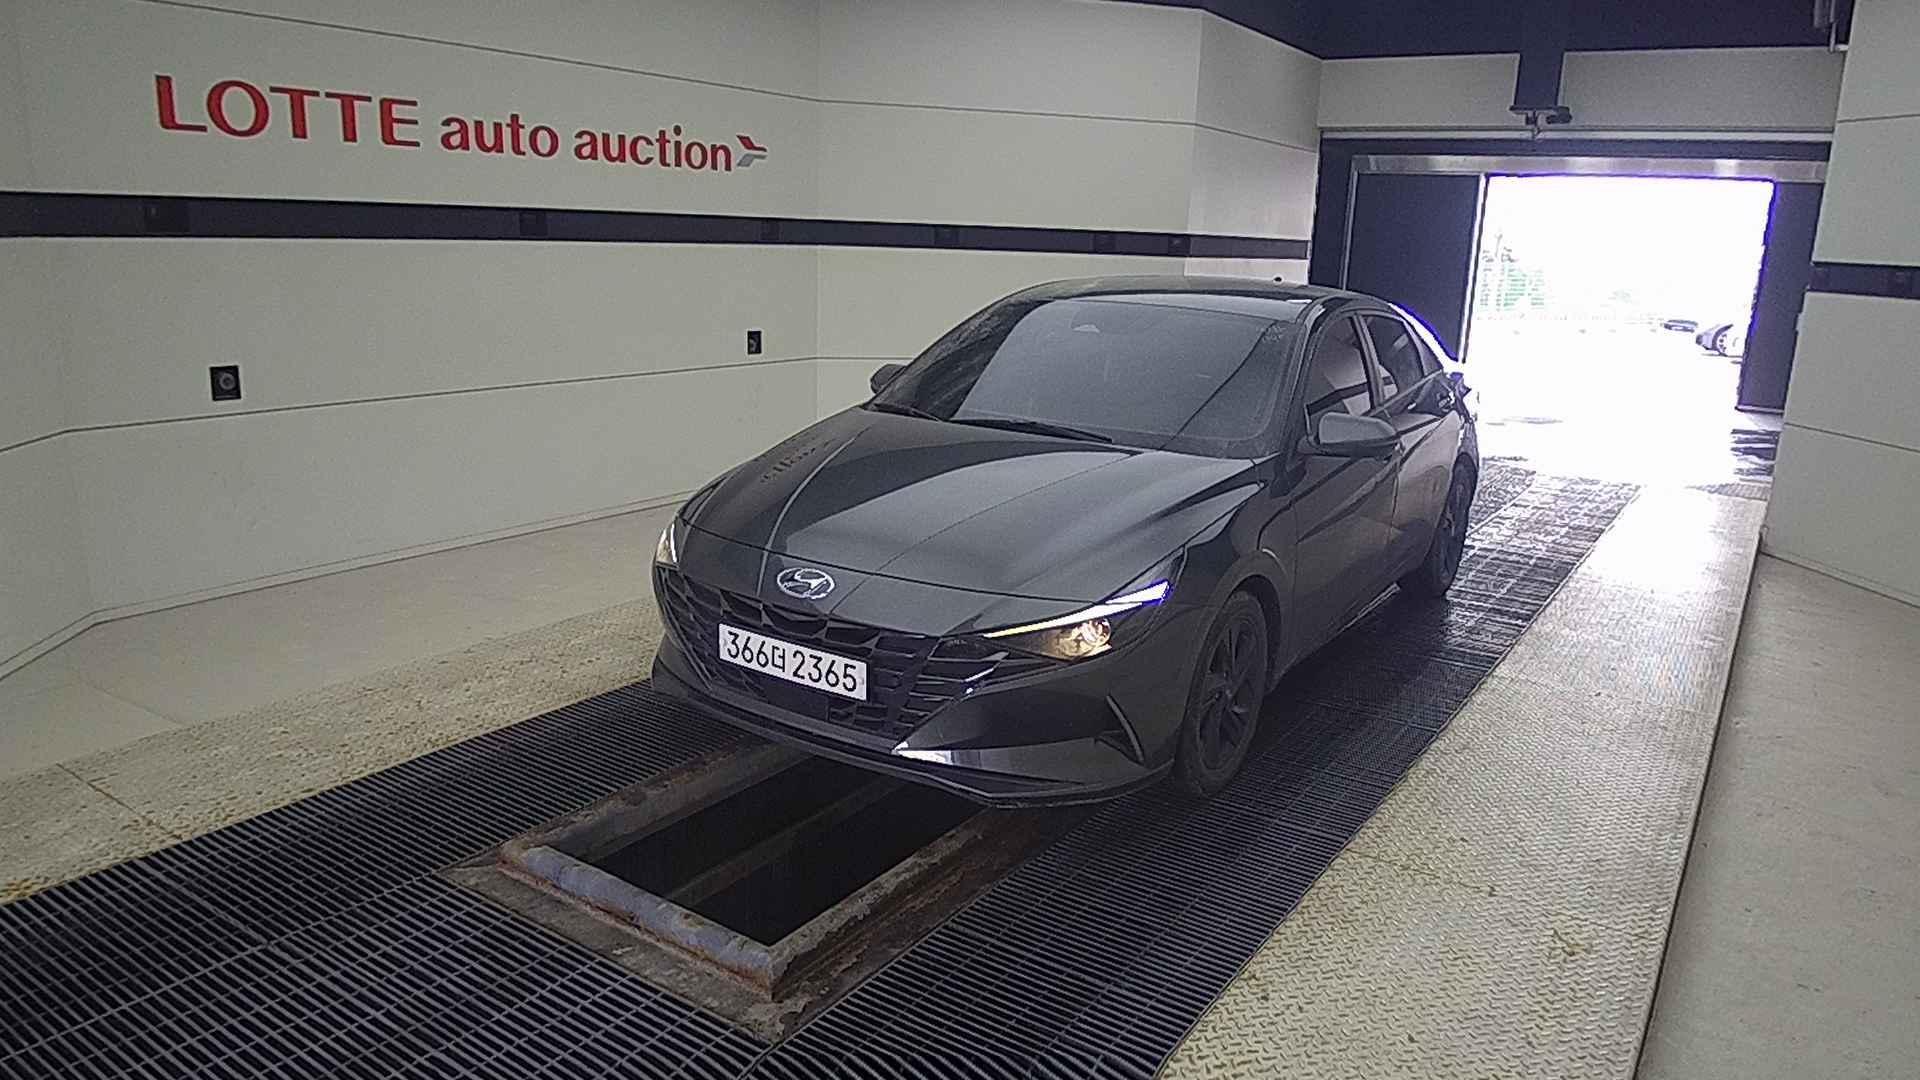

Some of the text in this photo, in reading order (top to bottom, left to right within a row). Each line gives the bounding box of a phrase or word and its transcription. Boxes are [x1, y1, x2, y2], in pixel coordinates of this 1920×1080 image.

[155, 75, 732, 171] LOTTE auto auction
[727, 630, 857, 692] 366더 2365
